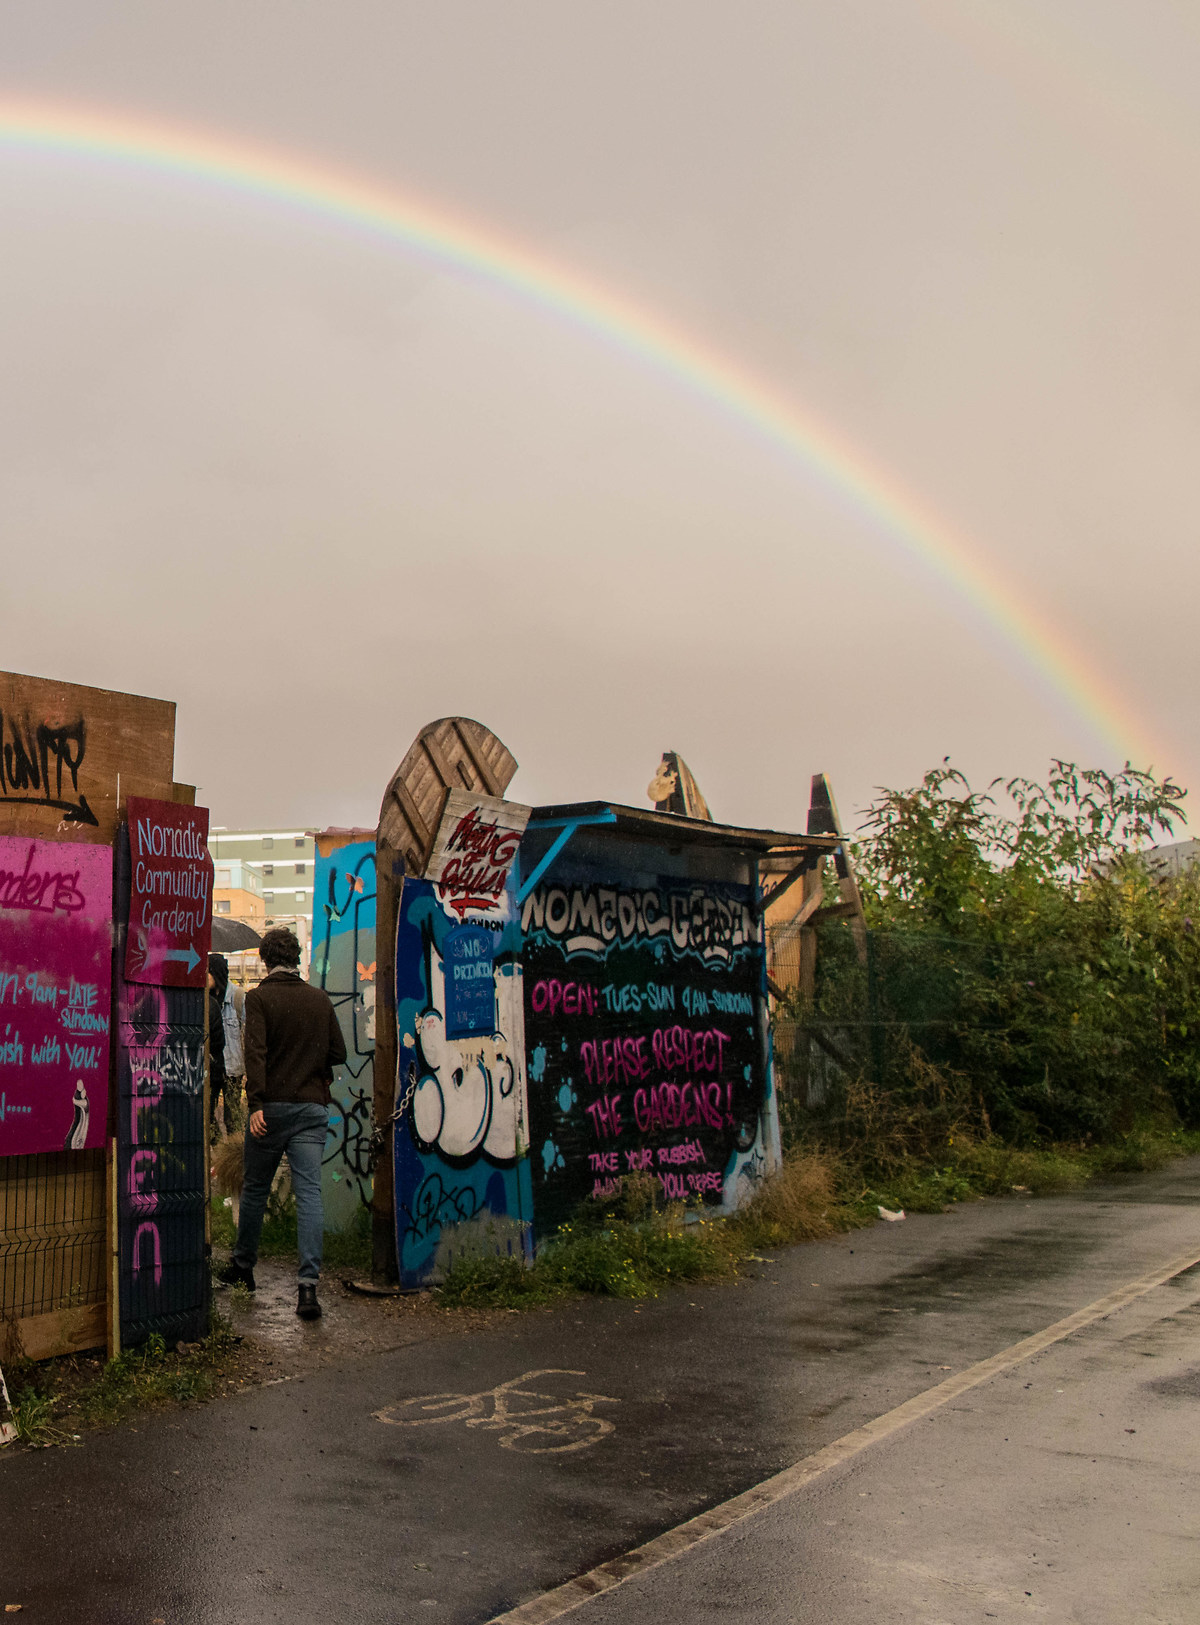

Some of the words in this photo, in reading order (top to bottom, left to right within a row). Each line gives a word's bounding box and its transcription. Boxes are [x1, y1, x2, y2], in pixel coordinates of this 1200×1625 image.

[137, 817, 205, 860] Nomadic
[135, 861, 209, 928] Community
[142, 900, 194, 936] Garden
[31, 1034, 61, 1064] with
[580, 1036, 650, 1085] PLEASE
[651, 1024, 732, 1073] RESPECT
[585, 1094, 623, 1138] THE
[588, 1152, 619, 1173] TAKE
